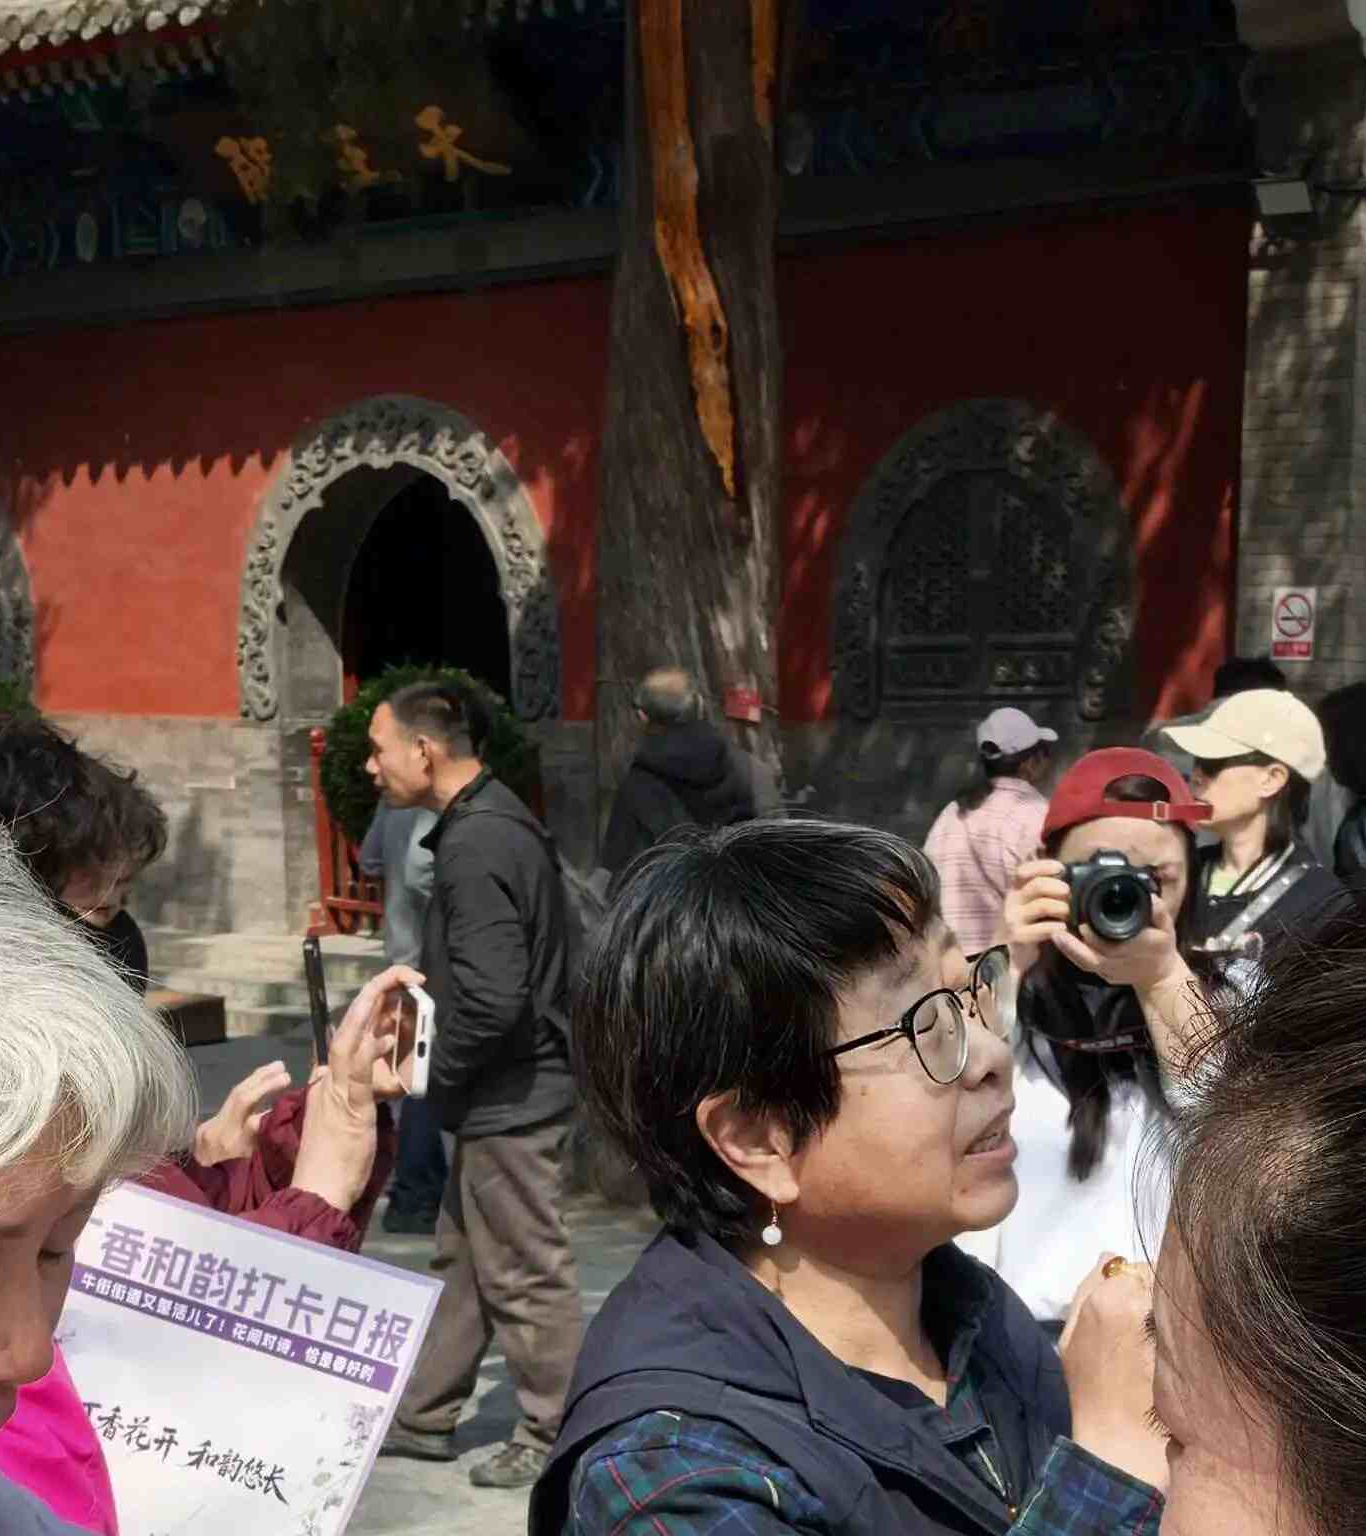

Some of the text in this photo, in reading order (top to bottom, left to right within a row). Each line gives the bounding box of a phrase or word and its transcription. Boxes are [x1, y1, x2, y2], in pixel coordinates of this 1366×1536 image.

[89, 1217, 413, 1363] 香和韵打卡日报
[185, 1440, 290, 1504] 和韵悠长
